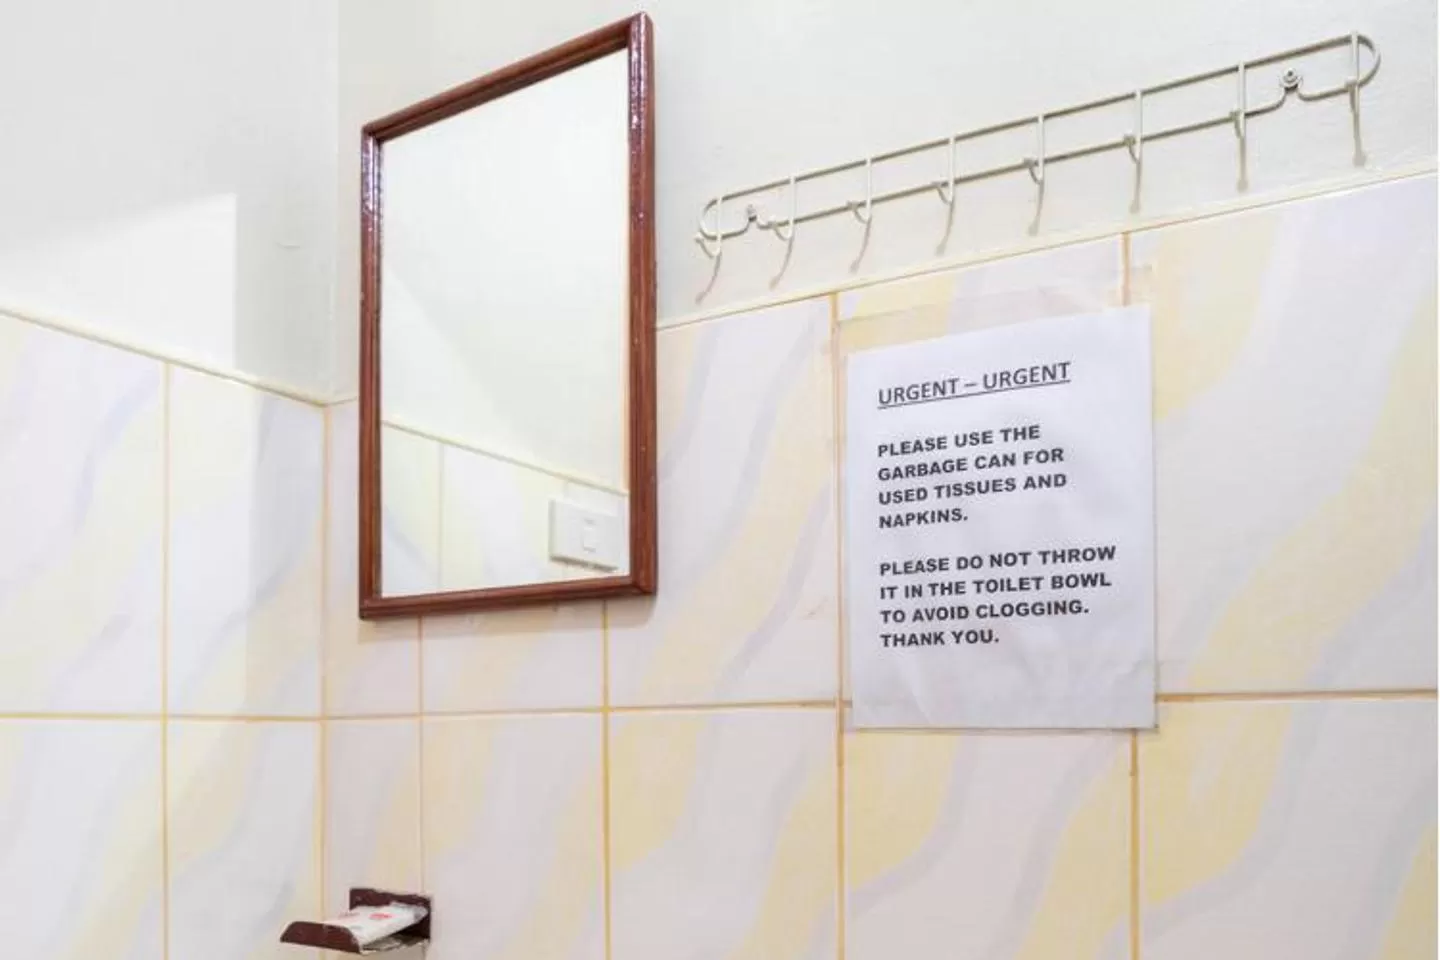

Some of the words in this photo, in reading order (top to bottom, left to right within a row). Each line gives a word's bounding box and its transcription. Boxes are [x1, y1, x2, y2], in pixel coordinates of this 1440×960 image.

[877, 378, 958, 409] URGENT
[983, 361, 1071, 391] URGENT
[878, 436, 947, 457] PLEASE
[955, 431, 993, 447] USE
[1000, 425, 1040, 442] THE
[878, 458, 968, 481] GARBAGE
[975, 452, 1016, 469] CAN
[1024, 448, 1064, 464] FOR
[878, 488, 928, 505] USED
[934, 477, 1016, 498] TISSUES
[1024, 474, 1067, 490] AND
[879, 509, 968, 528] NAPKINS.
[880, 559, 949, 576] PLEASE
[957, 554, 984, 570] DO
[990, 552, 1031, 568] NOT
[1039, 545, 1116, 565] THROW
[880, 586, 897, 599] IT
[905, 584, 922, 598] IN
[928, 581, 966, 597] THE
[973, 576, 1044, 595] TOILET
[1052, 572, 1111, 590] BOWL
[881, 609, 905, 624] TO
[912, 605, 969, 622] AVOID
[976, 599, 1089, 620] CLOGGING.
[881, 632, 945, 648] THANK
[952, 629, 999, 645] YOU.
